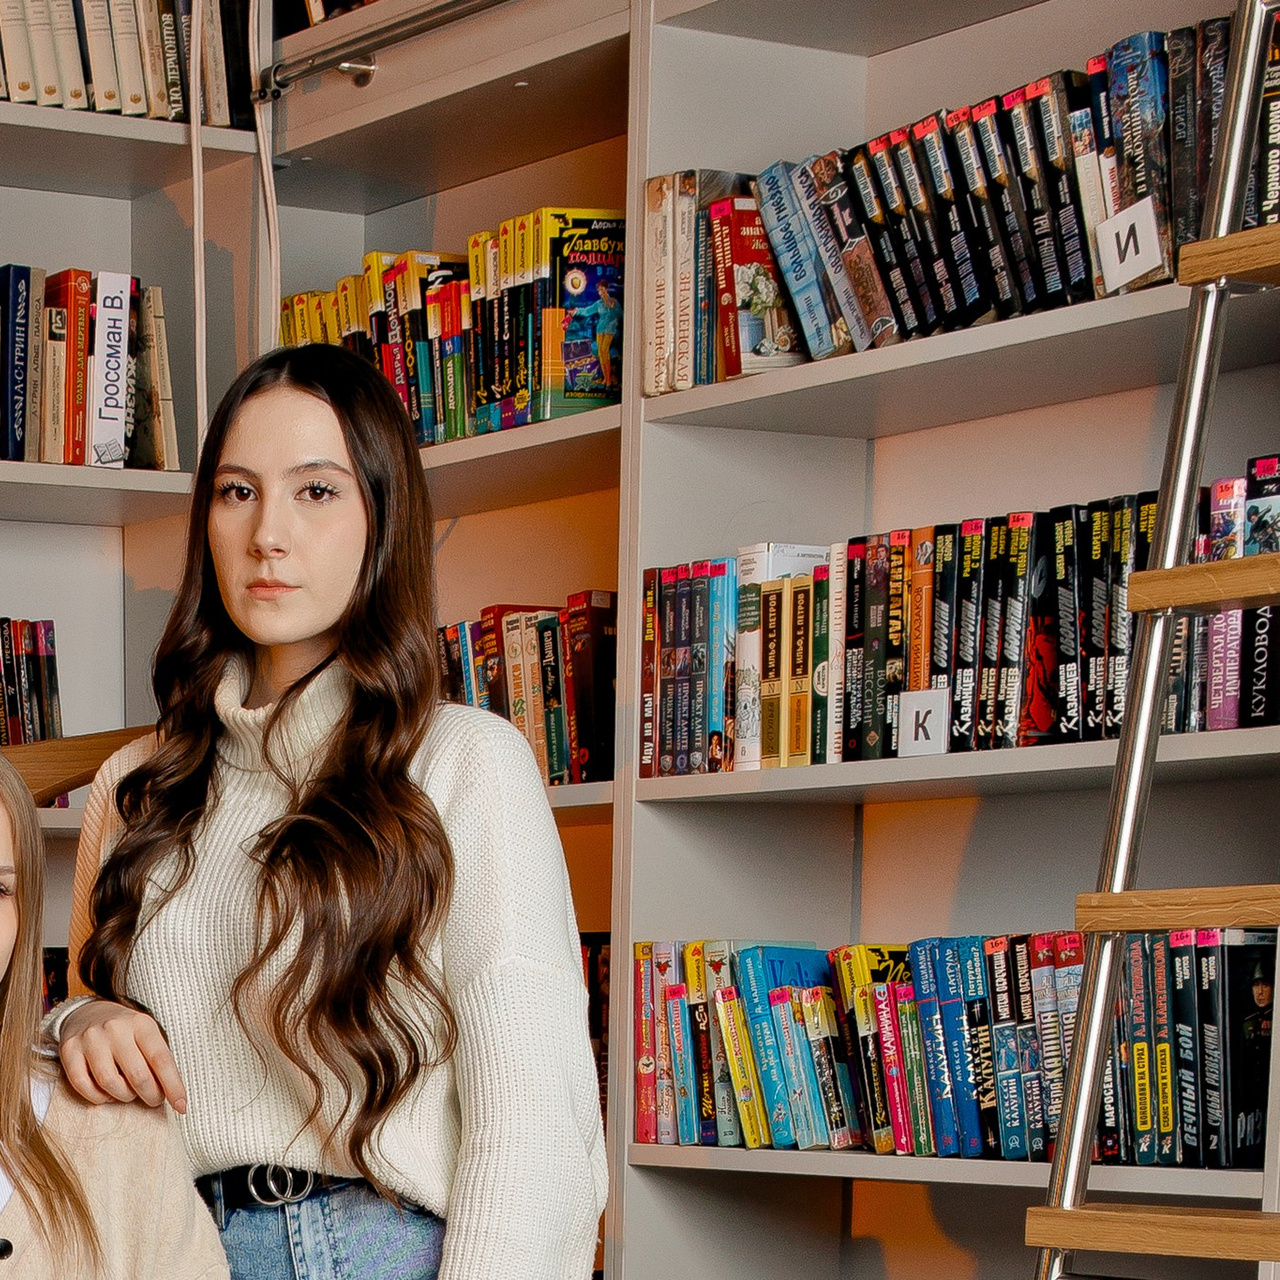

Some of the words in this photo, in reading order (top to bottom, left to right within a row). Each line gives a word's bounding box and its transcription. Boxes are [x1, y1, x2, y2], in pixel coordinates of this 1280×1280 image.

[103, 290, 123, 310] В.
[99, 318, 123, 420] Гроссман
[768, 594, 778, 628] ПЕТРОВ
[797, 593, 805, 625] ПЕТРОВ
[2, 622, 11, 664] ГРЕКОВА
[542, 640, 555, 675] Дышев
[954, 669, 963, 701] Кирилл
[1210, 634, 1224, 710] ЧЕТВЕРТАЯ
[643, 693, 653, 717] мы!
[864, 660, 874, 726] МЕССИНГ
[876, 670, 886, 715] ВОЛЬФ
[644, 723, 652, 737] на
[913, 709, 932, 741] К
[642, 742, 654, 764] Иду
[945, 949, 958, 994] ПАТРУЛЬ
[967, 960, 976, 996] Патруль
[1130, 941, 1145, 1023] КАРЕТНИКОВА
[1176, 1024, 1194, 1061] БОЙ
[1008, 1079, 1020, 1127] КАЛУГИН
[1033, 1079, 1044, 1128] КАЛУГИН
[1179, 1069, 1198, 1146] ВЕЧНЫЙ
